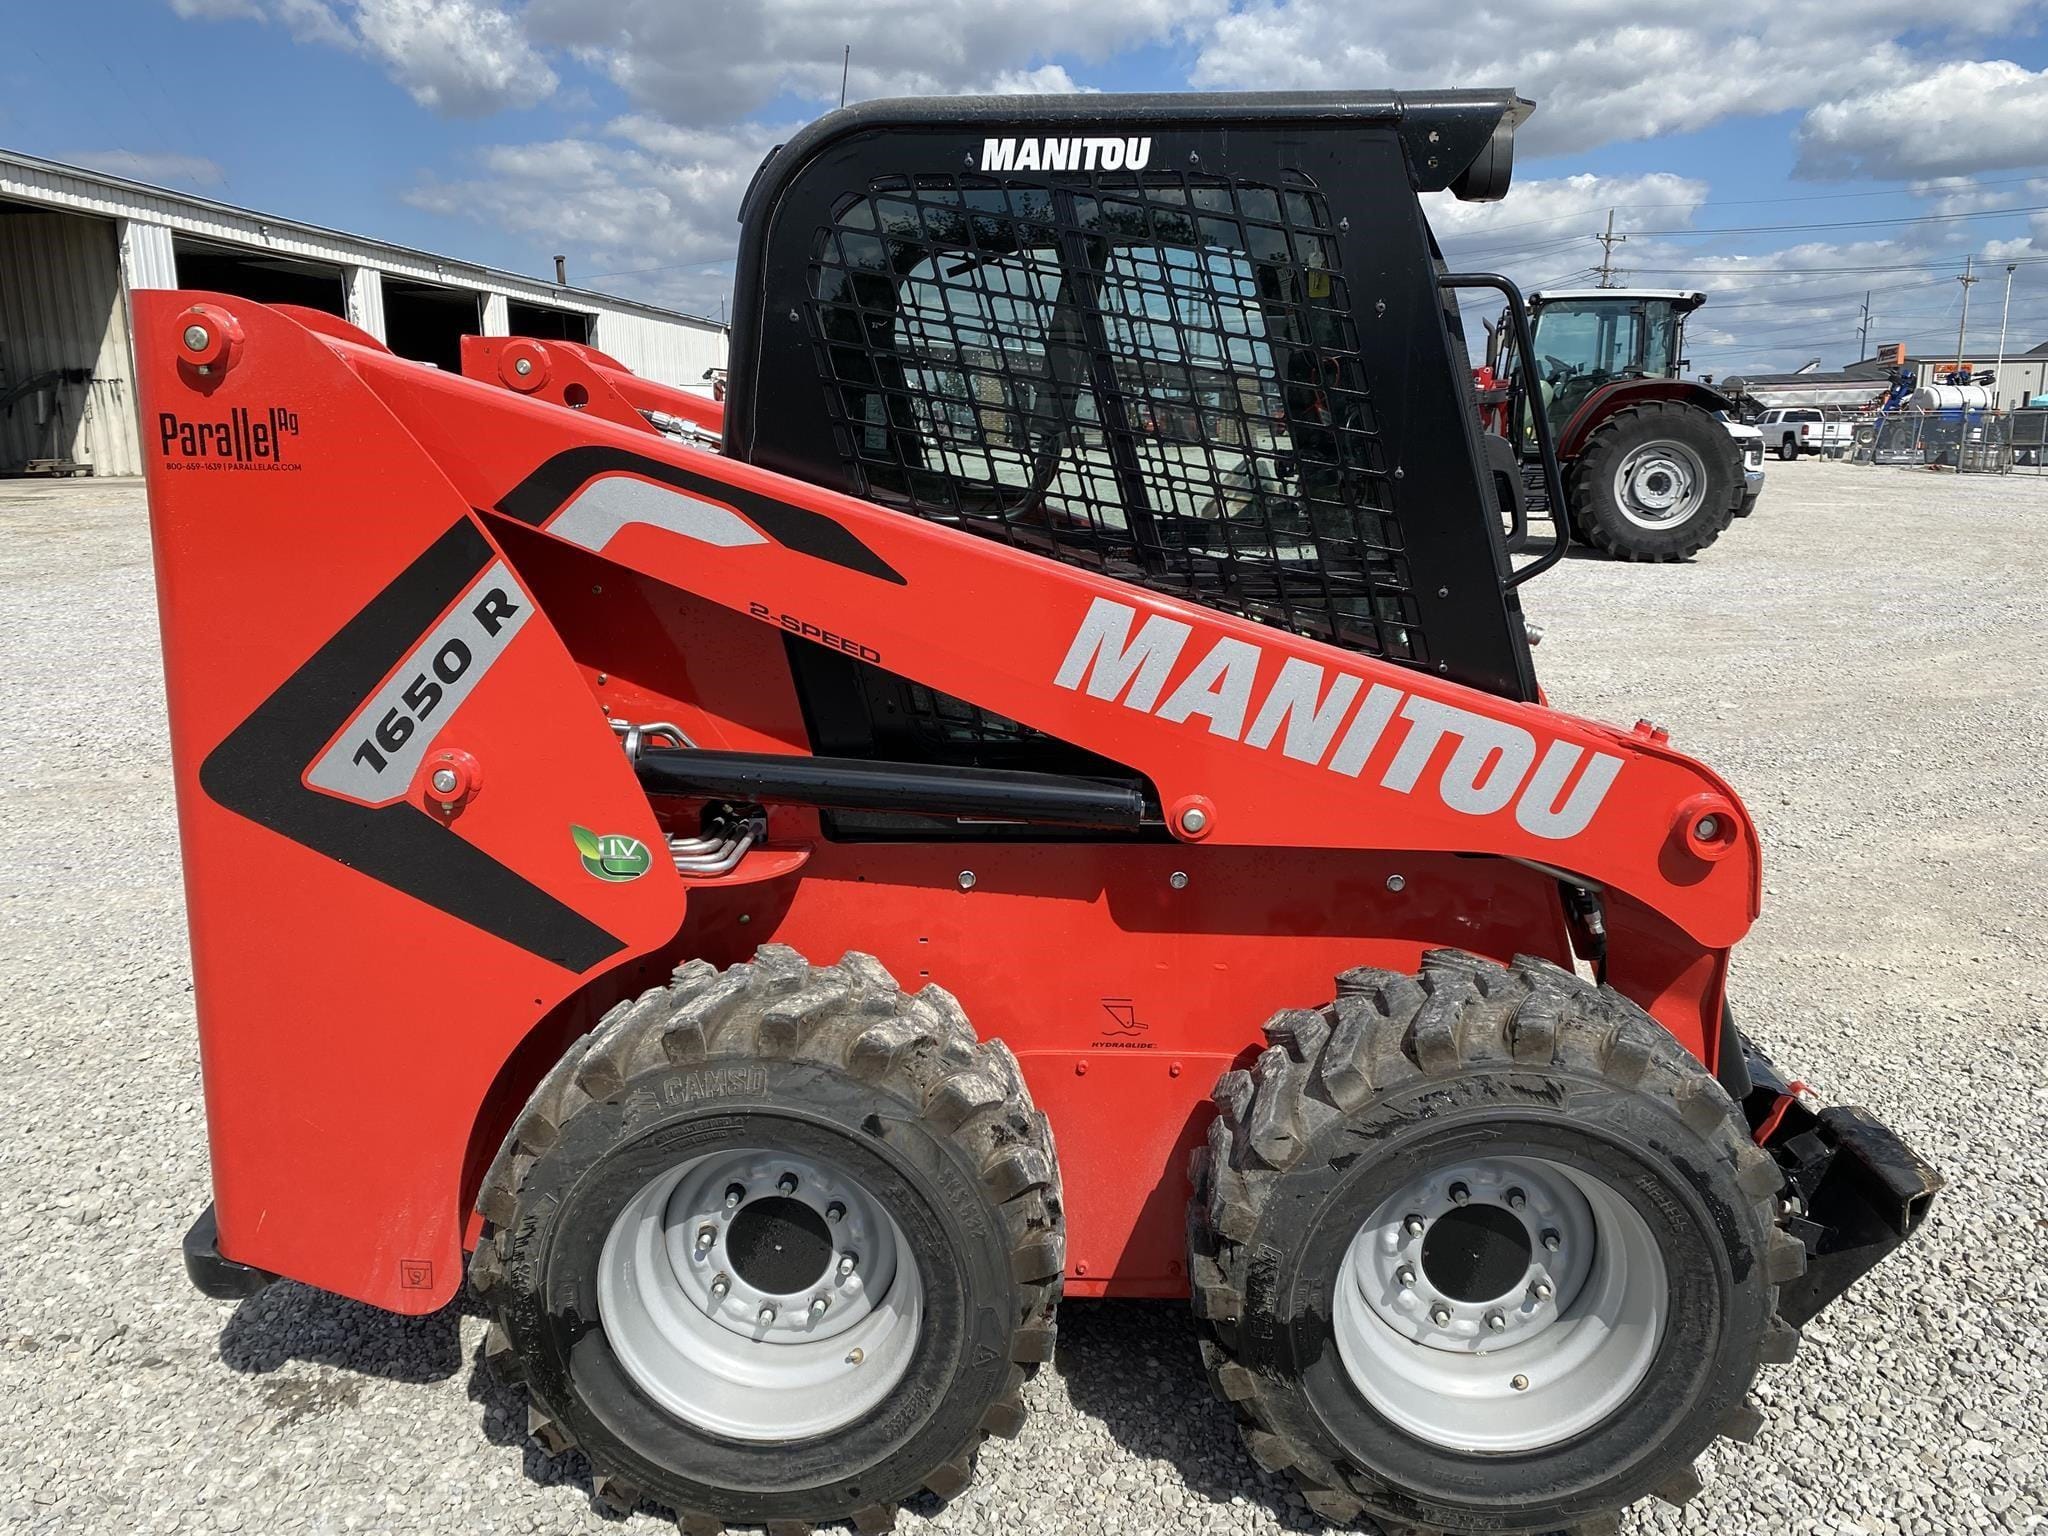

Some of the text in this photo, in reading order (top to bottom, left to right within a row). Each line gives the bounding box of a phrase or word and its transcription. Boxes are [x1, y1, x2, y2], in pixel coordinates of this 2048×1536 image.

[980, 137, 1152, 171] MANITOU
[166, 462, 302, 471] 800-659-1639 PARALLELAG.COM
[750, 602, 881, 664] 2-SPEED
[352, 588, 520, 774] 1650 R
[1053, 596, 1626, 839] MANITOU
[664, 1066, 769, 1107] CAMSO
